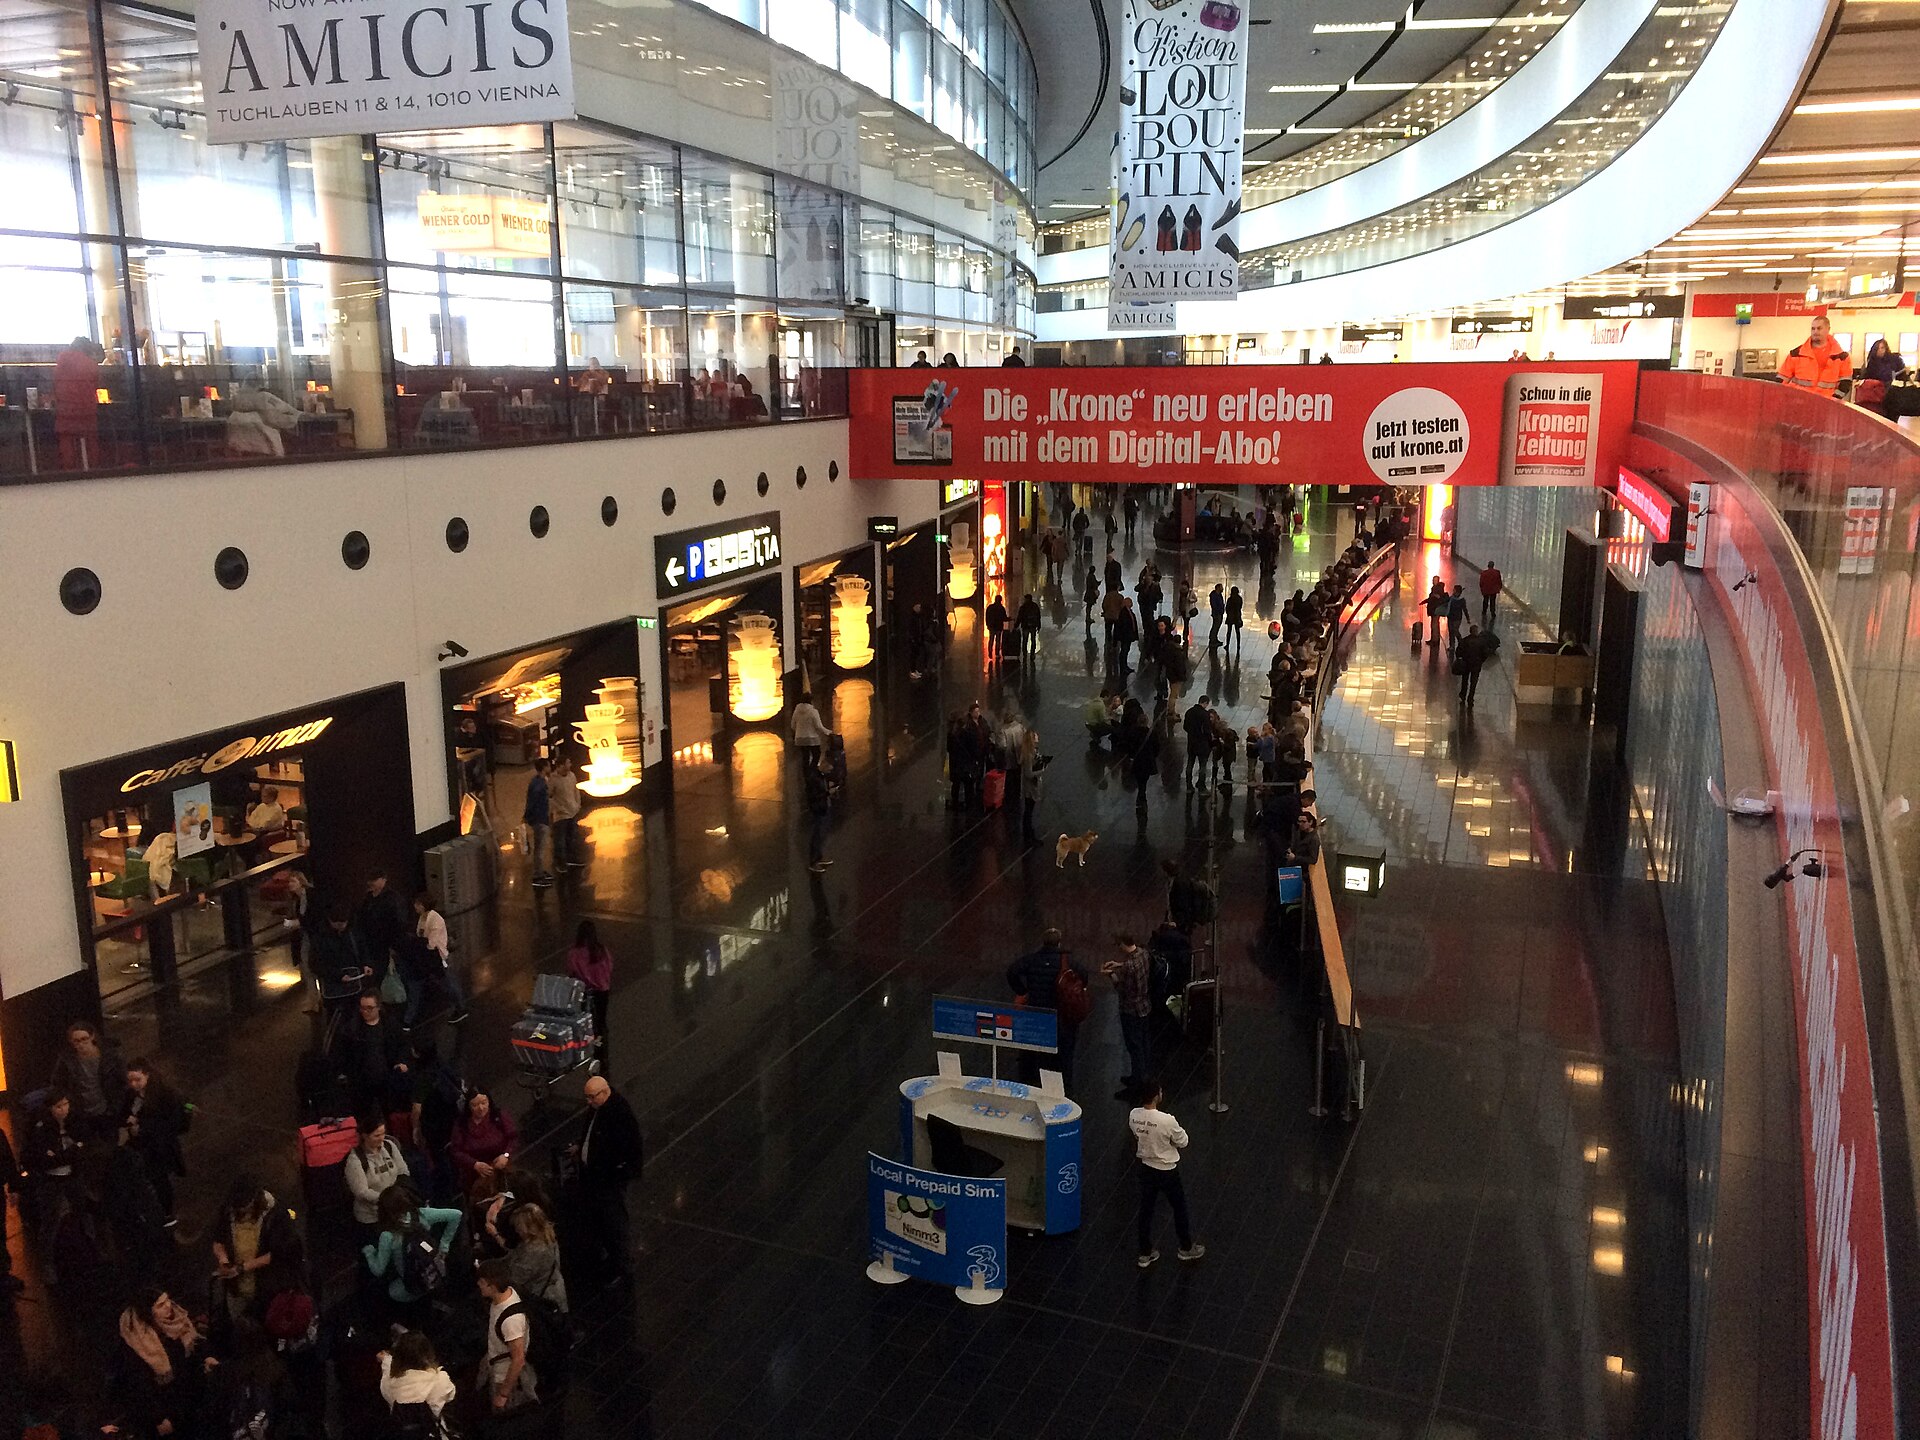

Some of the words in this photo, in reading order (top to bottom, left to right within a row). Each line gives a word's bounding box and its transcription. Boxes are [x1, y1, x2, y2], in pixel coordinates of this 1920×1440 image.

[218, 0, 554, 94] AMICIS
[1134, 18, 1239, 67] Christian
[217, 99, 348, 123] TUCHLAUBEN
[355, 98, 368, 112] 11
[375, 97, 389, 111] &
[395, 95, 420, 111] 14,
[428, 90, 472, 107] 1010
[477, 83, 561, 102] VIENNA
[1132, 63, 1238, 117] LOU
[1131, 107, 1234, 160] BOU
[1132, 150, 1235, 198] TIN
[422, 214, 459, 227] WIENER
[463, 214, 490, 226] GOLD
[501, 213, 533, 232] WIENER
[1121, 269, 1233, 289] AMICIS
[1111, 313, 1174, 324] AMICIS
[983, 387, 1028, 422] Die
[1036, 387, 1145, 425] „Krone“
[1153, 394, 1207, 422] neu
[1218, 387, 1333, 422] erleben
[1519, 386, 1556, 402] Schau
[1559, 386, 1570, 401] in
[1573, 386, 1592, 402] die
[1375, 421, 1407, 441] Jetzt
[1412, 417, 1460, 434] testen
[1519, 409, 1588, 433] Kronen
[983, 429, 1028, 463] mit
[1037, 429, 1098, 463] dem
[1108, 430, 1281, 468] Digital-Abo!
[1371, 441, 1396, 460] auf
[1400, 436, 1463, 456] krone.at
[1517, 432, 1587, 460] Zeitung
[1515, 467, 1585, 476] www.krone.at
[689, 545, 702, 578] P
[870, 1159, 903, 1184] Local
[905, 1172, 961, 1196] Prepaid
[965, 1183, 1000, 1199] Sim.
[902, 1222, 940, 1244] Nimm3
